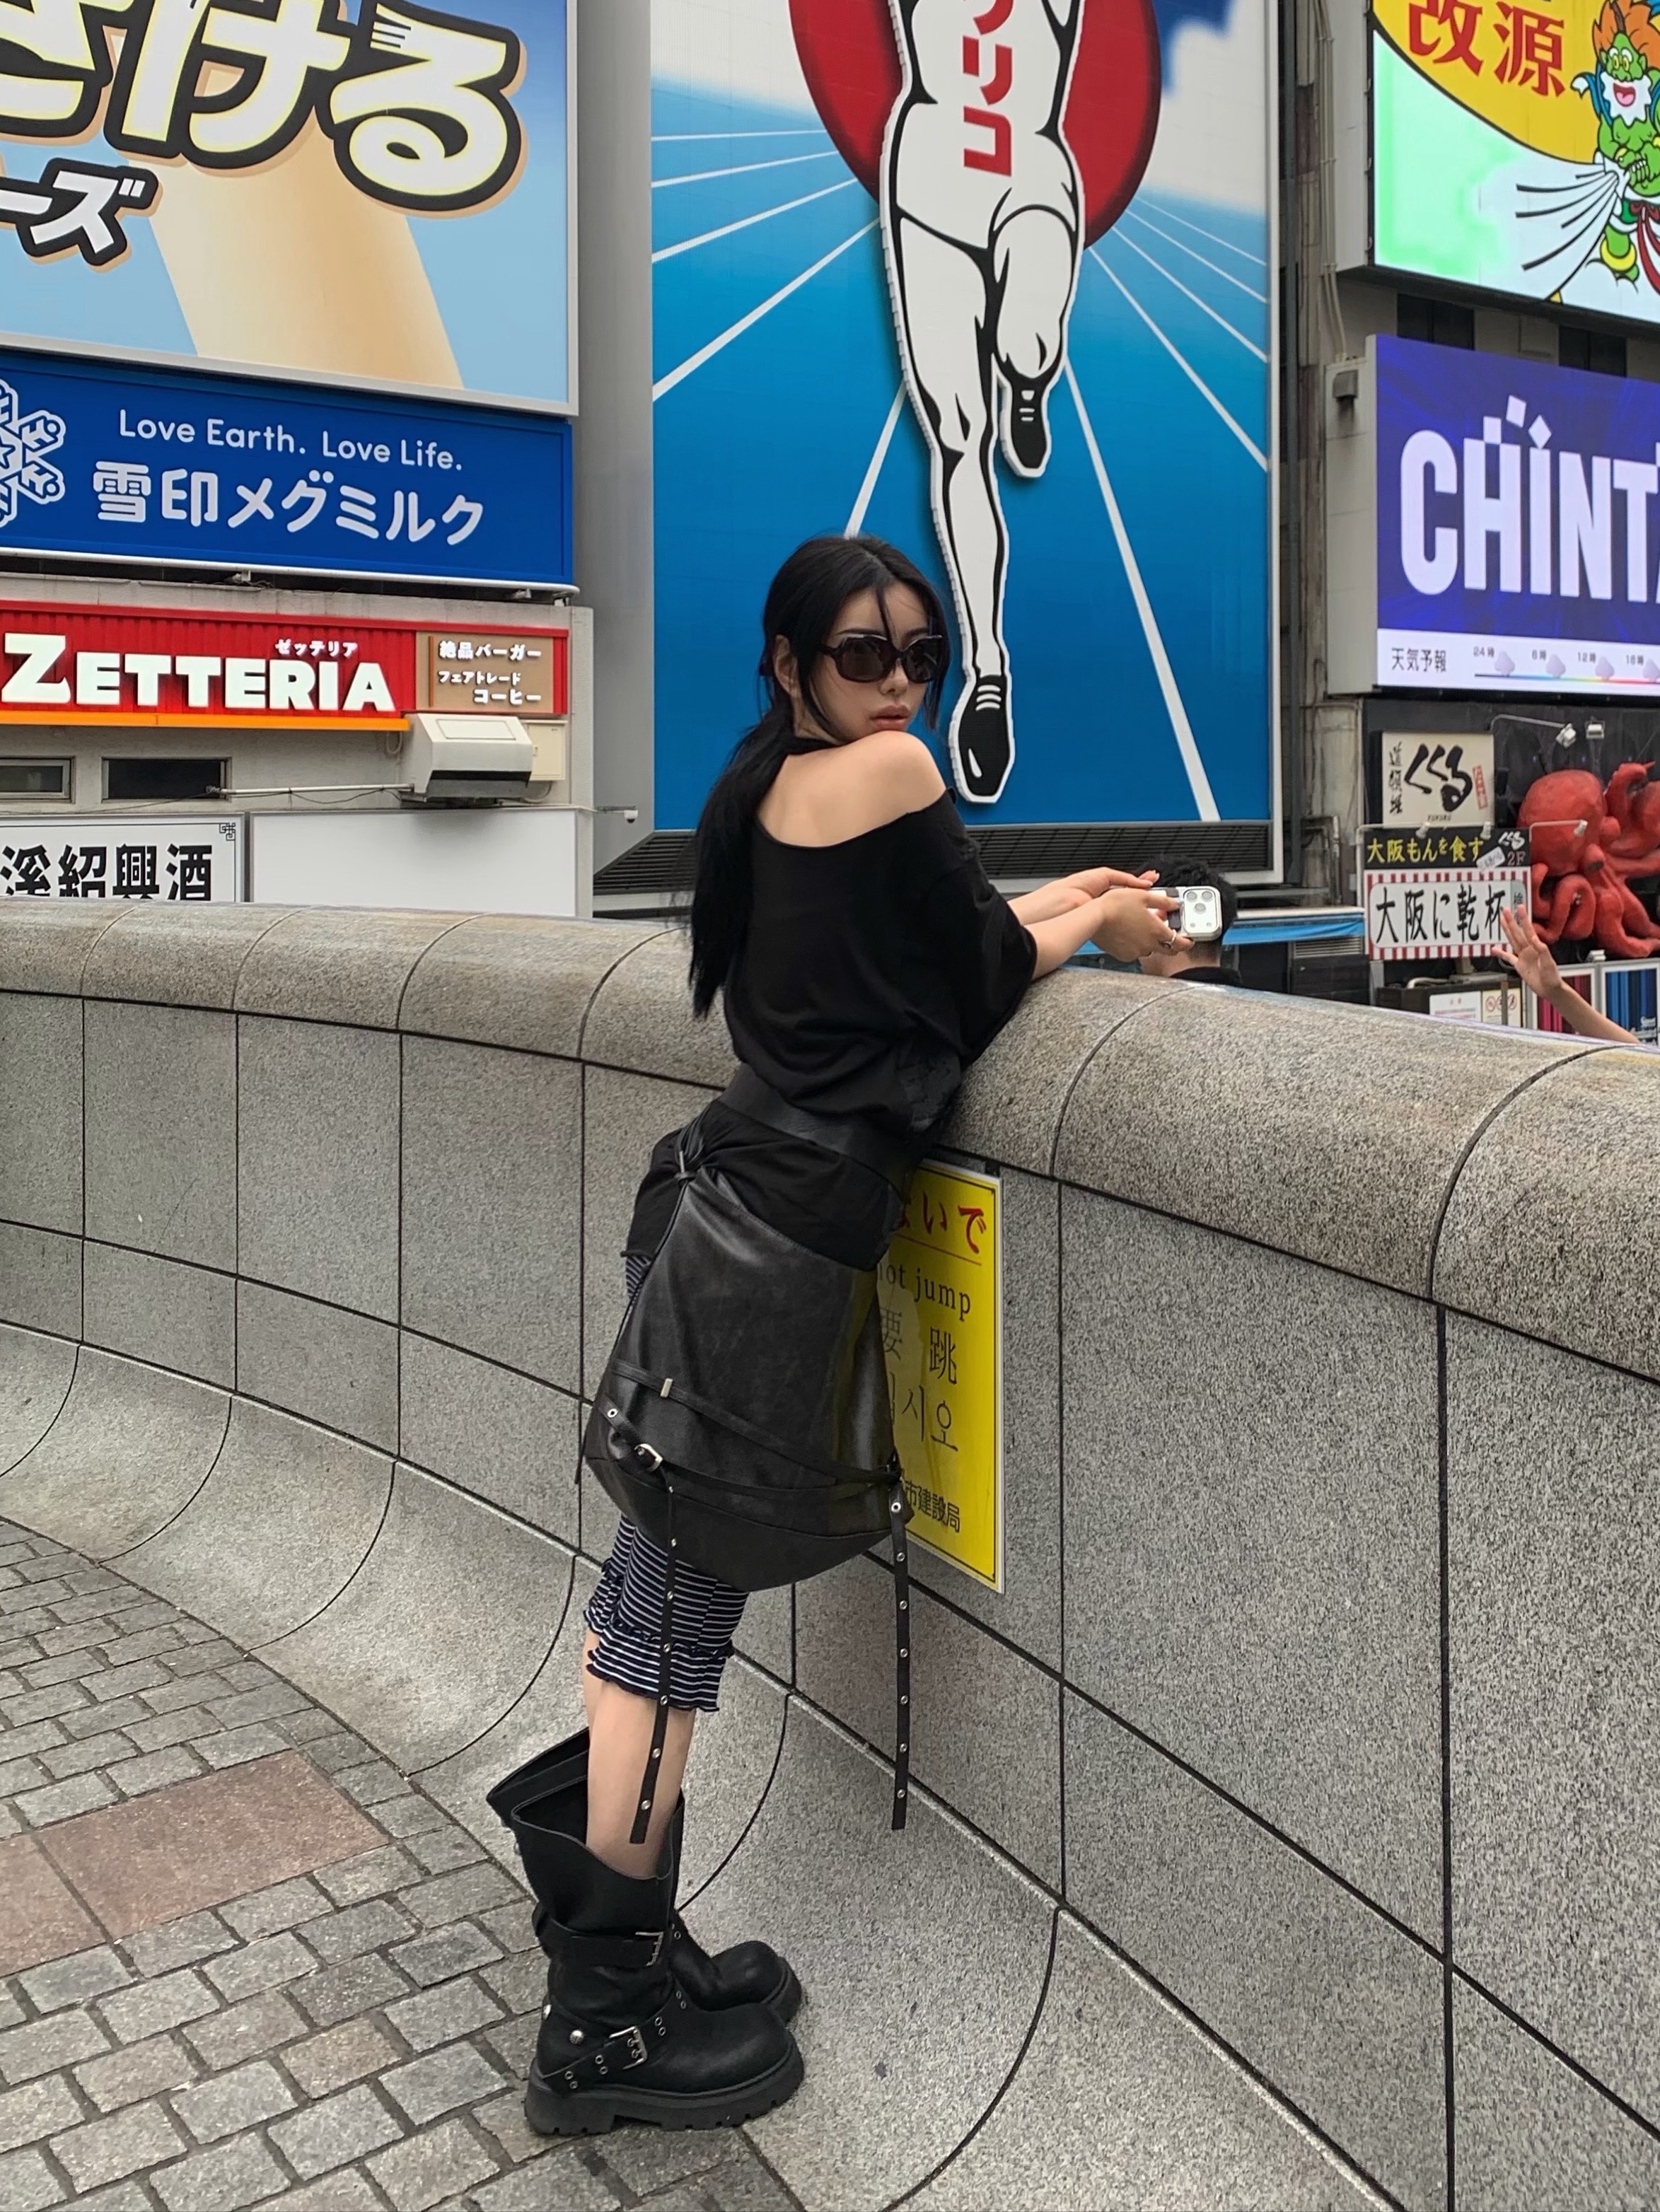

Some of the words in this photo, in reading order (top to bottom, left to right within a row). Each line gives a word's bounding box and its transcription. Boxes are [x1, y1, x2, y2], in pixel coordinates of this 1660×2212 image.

[1408, 0, 1565, 98] 改源
[120, 409, 195, 443] Love
[207, 419, 306, 454] Earth.
[322, 431, 390, 463] Love
[401, 439, 463, 471] Life.
[93, 460, 484, 546] 雪印メグミルク
[1400, 407, 1660, 604] CHINT
[1, 632, 397, 713] ZETTERIA
[274, 638, 359, 658] ゼッテリア
[439, 641, 542, 661] 絶品バーガー
[1391, 647, 1447, 673] 天気予報
[439, 670, 521, 686] フェアトレード
[474, 689, 542, 705] コーヒー
[1403, 743, 1473, 813] くくる
[1366, 835, 1484, 864] 大阪もんを食す
[1507, 851, 1526, 866] 2F
[1376, 884, 1506, 944] 大阪に乾杯
[914, 1268, 971, 1322] jump
